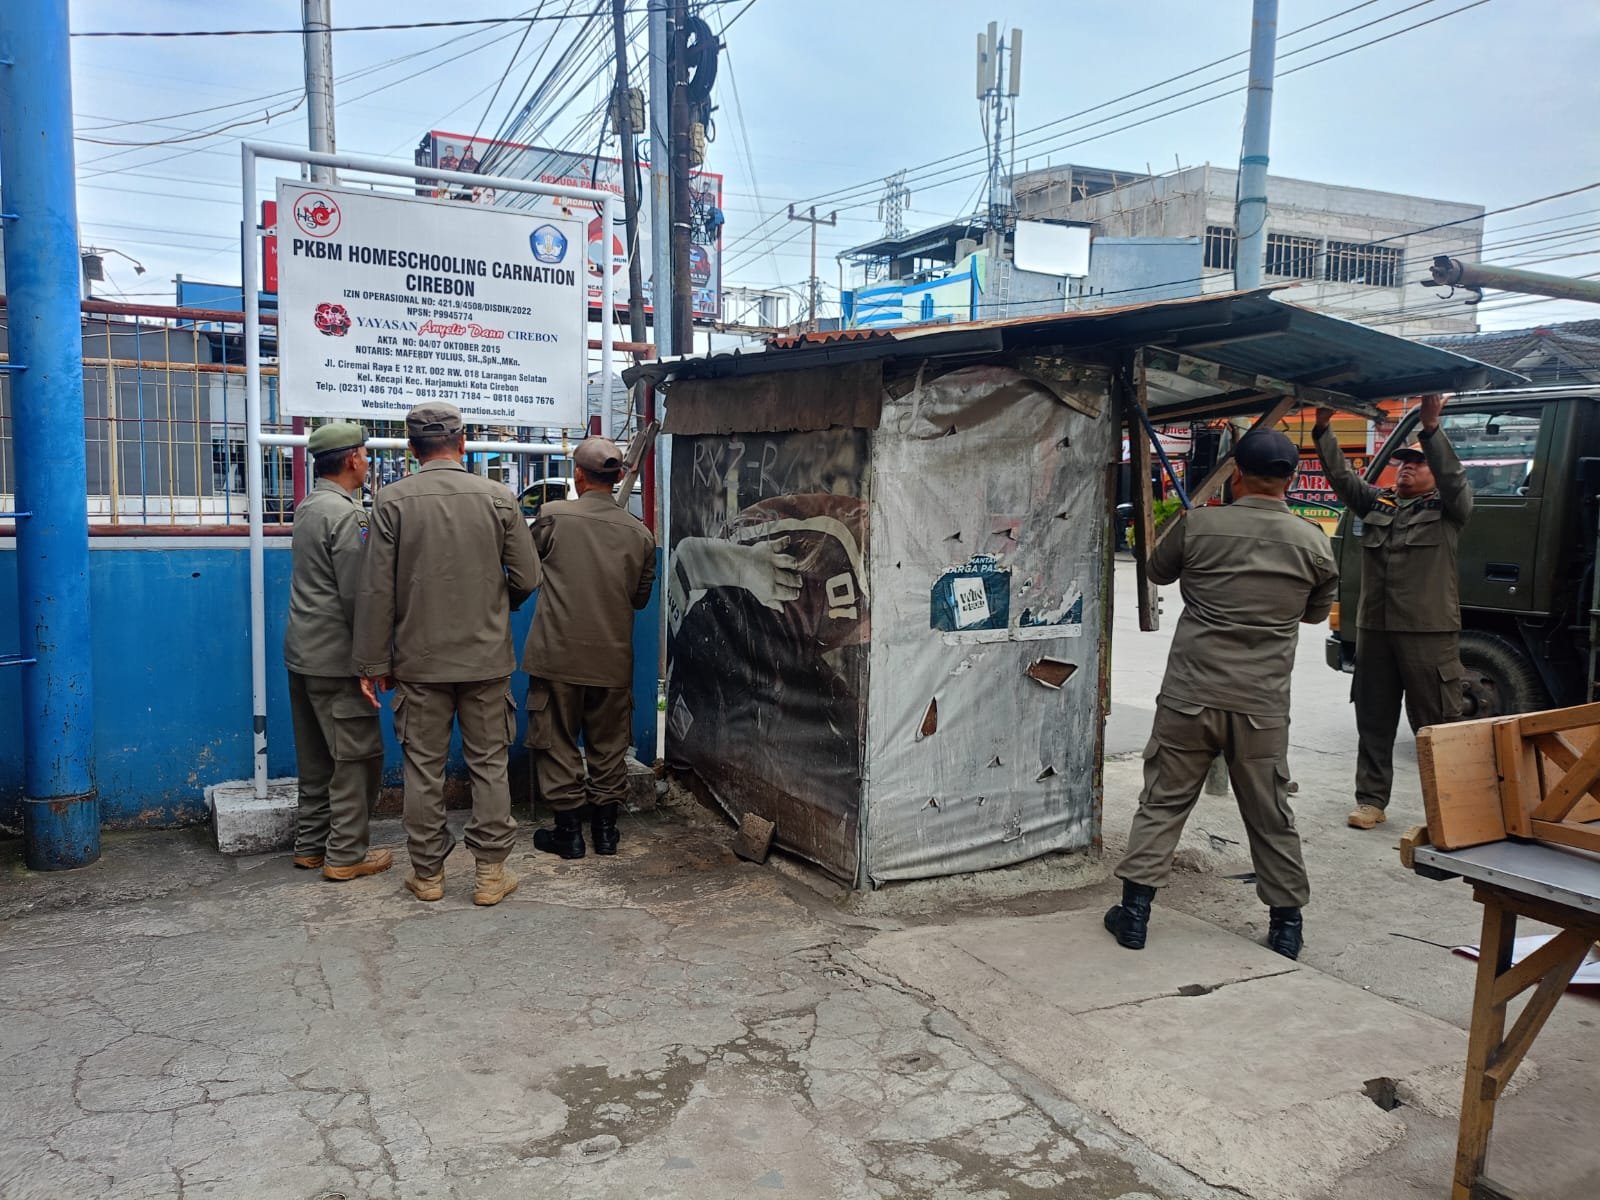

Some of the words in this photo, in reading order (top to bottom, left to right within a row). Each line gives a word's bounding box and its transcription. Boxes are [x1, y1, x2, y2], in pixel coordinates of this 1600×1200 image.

[293, 238, 342, 260] PKBM
[348, 245, 487, 277] HOMESCHOOLING
[492, 261, 575, 286] CARNATION
[406, 274, 475, 297] CIREBON
[343, 289, 360, 299] IZIN
[362, 291, 420, 305] OPERASIONAL
[421, 297, 436, 306] NO:
[437, 298, 532, 315] 421.9/4508/DISDIK/2022
[407, 306, 431, 317] NPSN:
[433, 309, 473, 321] P9945774
[356, 316, 418, 331] YAYASAN
[507, 330, 559, 343] CIREBON
[355, 345, 393, 356] NOTARIS:
[395, 348, 433, 360] MAFERDY
[435, 351, 466, 363] YULIUS,
[377, 335, 398, 345] AKTA
[402, 337, 417, 347] NO:
[418, 338, 441, 349] 04/07
[443, 341, 479, 352] OKTOBER
[481, 344, 501, 354] 2015
[337, 359, 370, 370] Ciremai
[372, 362, 393, 373] Raya
[395, 364, 401, 373] E
[402, 365, 413, 374] 12
[415, 365, 428, 375] RT.
[430, 366, 445, 376] 002
[447, 368, 462, 377] RW.
[464, 369, 479, 378] 018
[481, 370, 517, 382] Larangan
[519, 373, 547, 383] Selatan
[357, 372, 373, 382] Kel.
[375, 374, 403, 385] Kecapi
[405, 376, 422, 386] Kec.
[425, 378, 468, 388] Harjamukti
[470, 380, 488, 390] Kota
[489, 382, 519, 392] Cirebon
[316, 381, 336, 392] Telp.
[339, 383, 366, 395] (0231)
[369, 384, 385, 394] 486
[388, 386, 403, 395] 704
[416, 388, 437, 398] 0813
[438, 389, 458, 399] 2371
[461, 391, 480, 400] 7184
[493, 393, 512, 403] 0818
[514, 395, 534, 404] 0463
[535, 396, 555, 406] 7676
